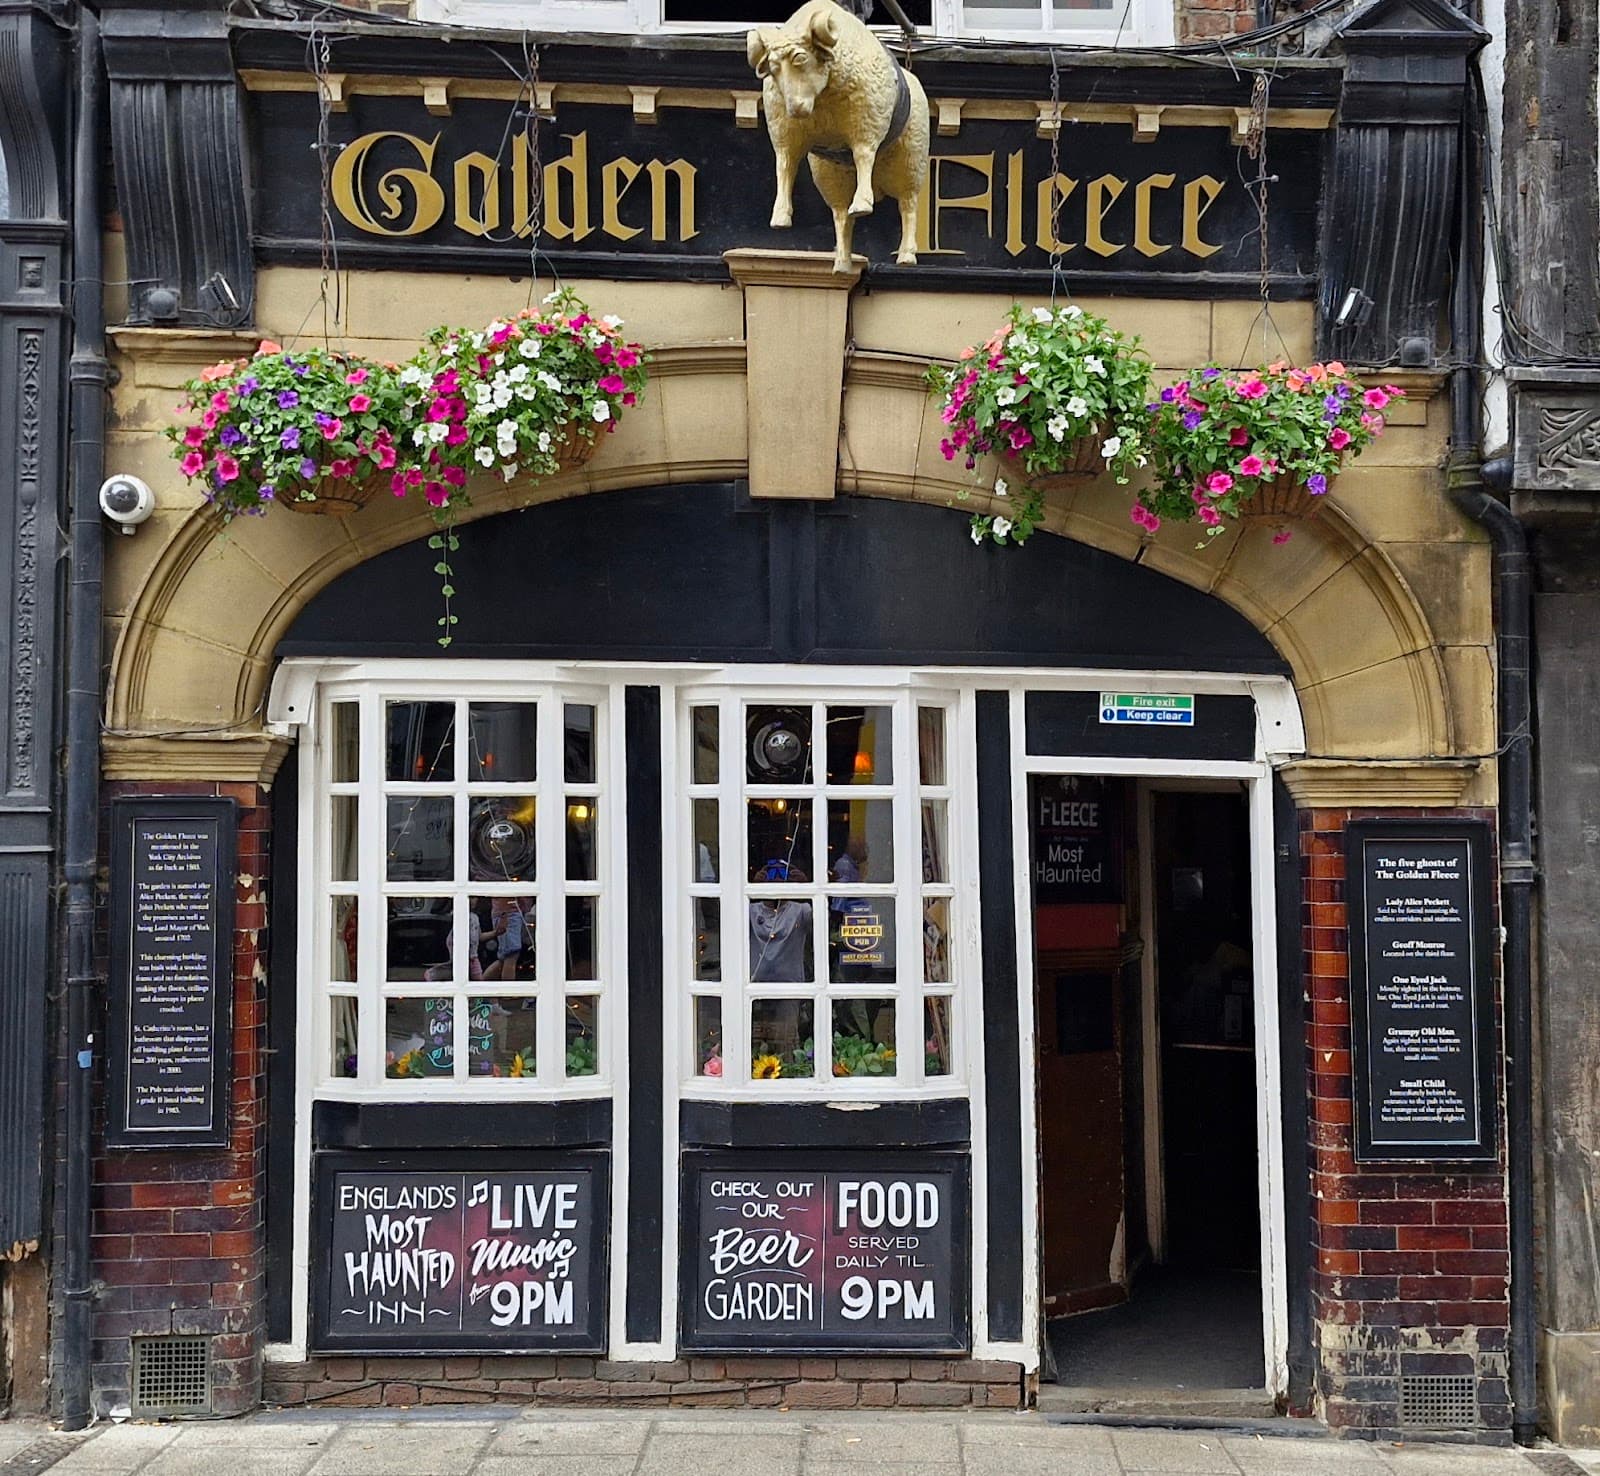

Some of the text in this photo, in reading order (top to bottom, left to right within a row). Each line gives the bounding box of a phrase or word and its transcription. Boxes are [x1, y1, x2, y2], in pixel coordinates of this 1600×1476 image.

[331, 130, 1226, 258] Golden Fleece
[1132, 696, 1176, 707] Fire exit
[1126, 710, 1183, 721] Keep clear
[1040, 797, 1098, 827] FLEECE
[1048, 844, 1084, 863] Most
[1378, 858, 1458, 869] The five ghosts of
[1036, 861, 1102, 883] Haunted
[1375, 871, 1460, 879] The Golden Fleece
[1386, 898, 1403, 907] Lady
[1411, 976, 1429, 985] Eyed
[1430, 976, 1447, 985] Jack
[1388, 1028, 1420, 1037] Grumpy
[340, 1185, 457, 1210] ENGLAND'S
[711, 1181, 814, 1199] CHECK OUT
[491, 1183, 578, 1229] LIVE
[742, 1202, 785, 1219] OUR
[838, 1181, 939, 1229] FOOD
[365, 1214, 432, 1252] MOST
[848, 1236, 919, 1250] SERVED
[471, 1231, 577, 1276] Music
[709, 1227, 815, 1275] Beer
[835, 1255, 889, 1269] DAILY
[345, 1249, 455, 1299] HAUNTED
[490, 1281, 573, 1326] 9PM
[704, 1278, 813, 1321] GARDEN
[841, 1275, 935, 1321] 9PM
[369, 1301, 425, 1324] INN
